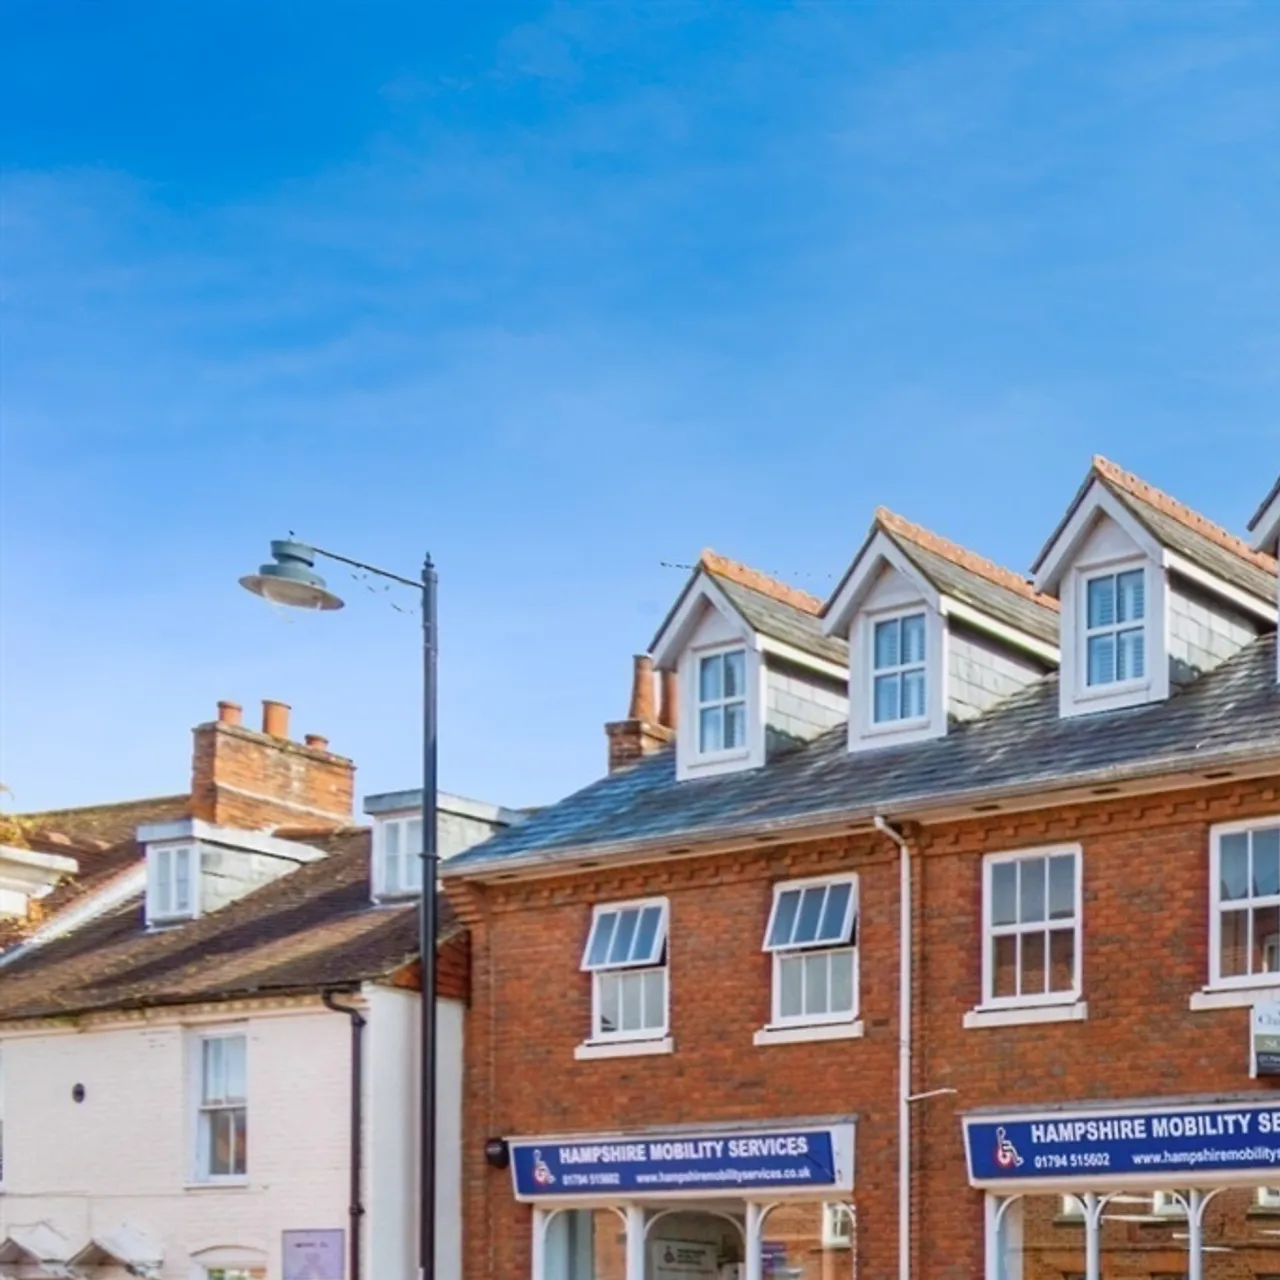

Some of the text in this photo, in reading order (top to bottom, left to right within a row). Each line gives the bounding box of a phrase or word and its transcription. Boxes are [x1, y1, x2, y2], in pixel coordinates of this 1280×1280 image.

[1031, 1119, 1146, 1143] HAMPSHIRE
[1152, 1113, 1251, 1138] MOBILITY
[559, 1136, 808, 1165] HAMPSHIRE MOBILITY SERVICES
[1034, 1154, 1068, 1169] 01794
[636, 1165, 811, 1184] www.hampshiremobilityservices.co.uk
